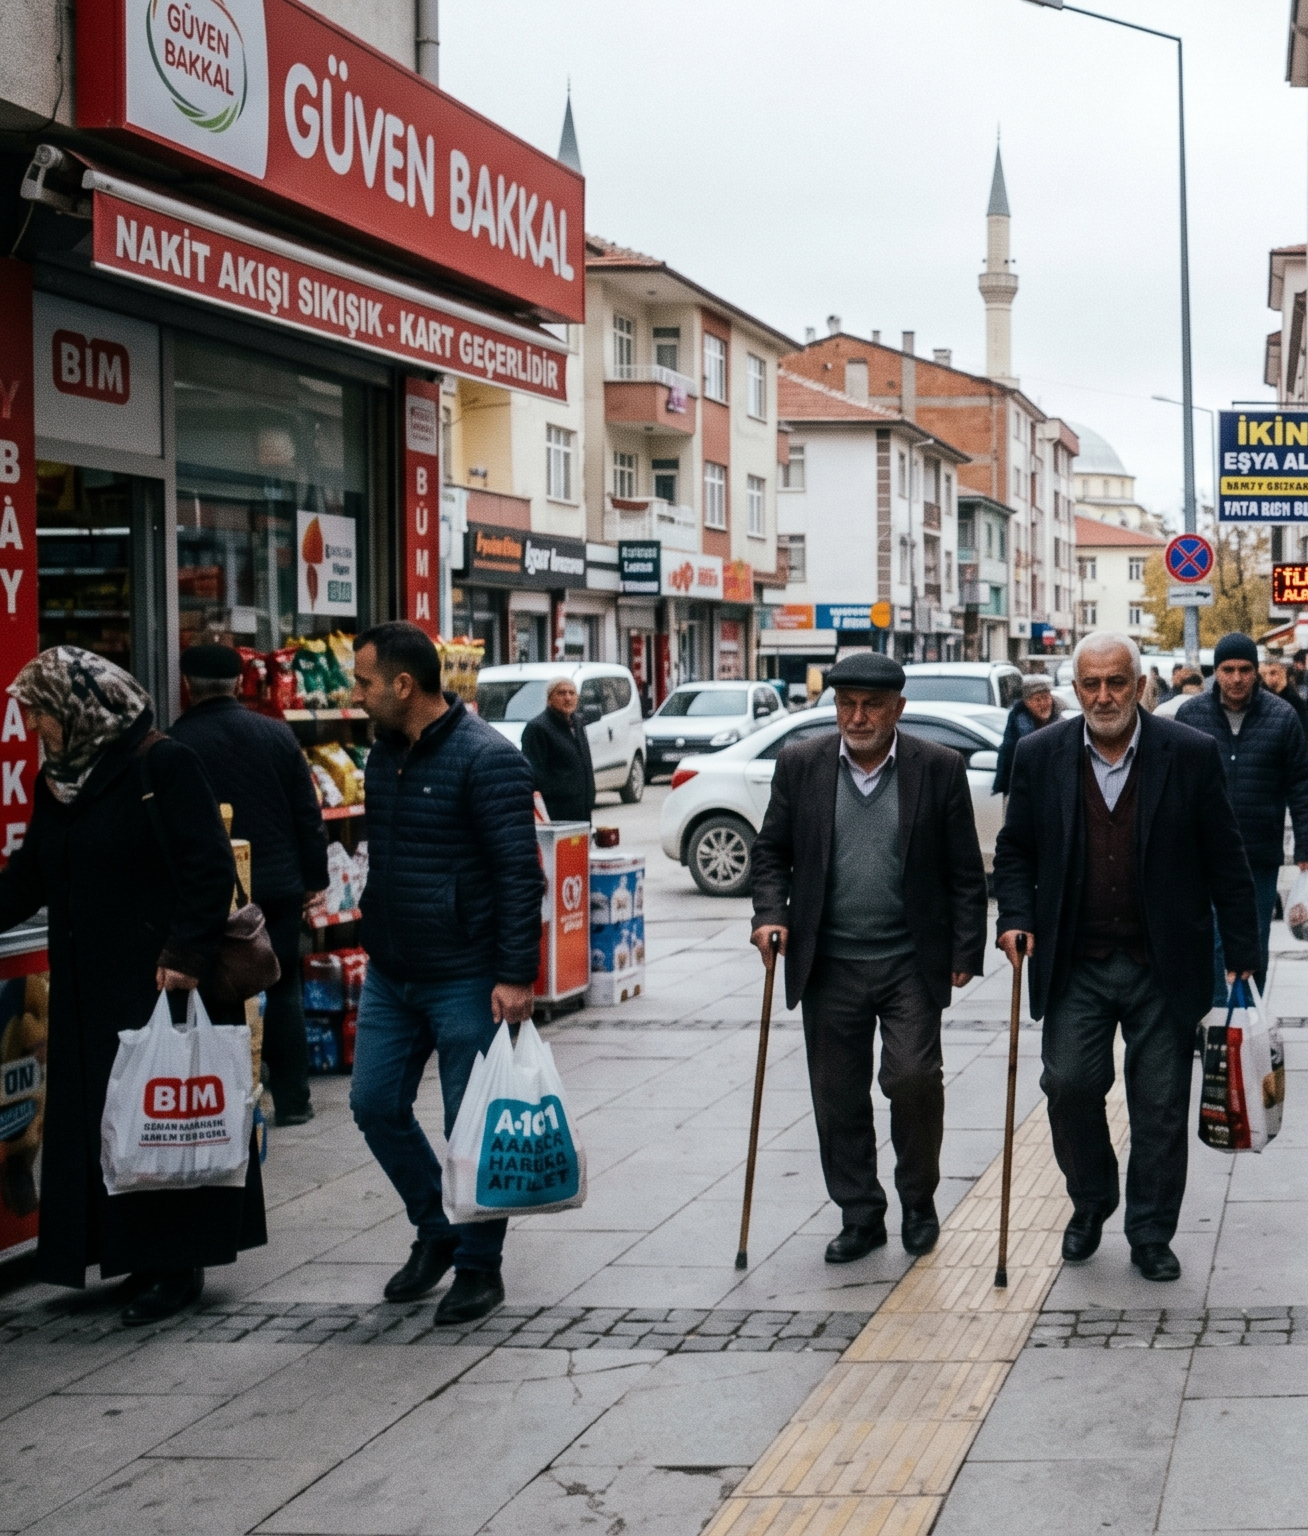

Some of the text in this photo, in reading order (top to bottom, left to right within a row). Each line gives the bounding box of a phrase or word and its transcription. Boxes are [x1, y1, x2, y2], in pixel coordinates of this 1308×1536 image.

[167, 3, 228, 59] GÜVEN
[165, 38, 234, 96] BAKKAL
[284, 54, 574, 281] GÜVEN BAKKAL
[116, 214, 211, 283] NAKİT
[218, 251, 290, 315] AKIŞI
[298, 277, 384, 338] SIKIŞIK
[400, 310, 454, 358] KART
[459, 331, 559, 391] GEÇERLİDİR
[1223, 452, 1279, 474] EŞYA
